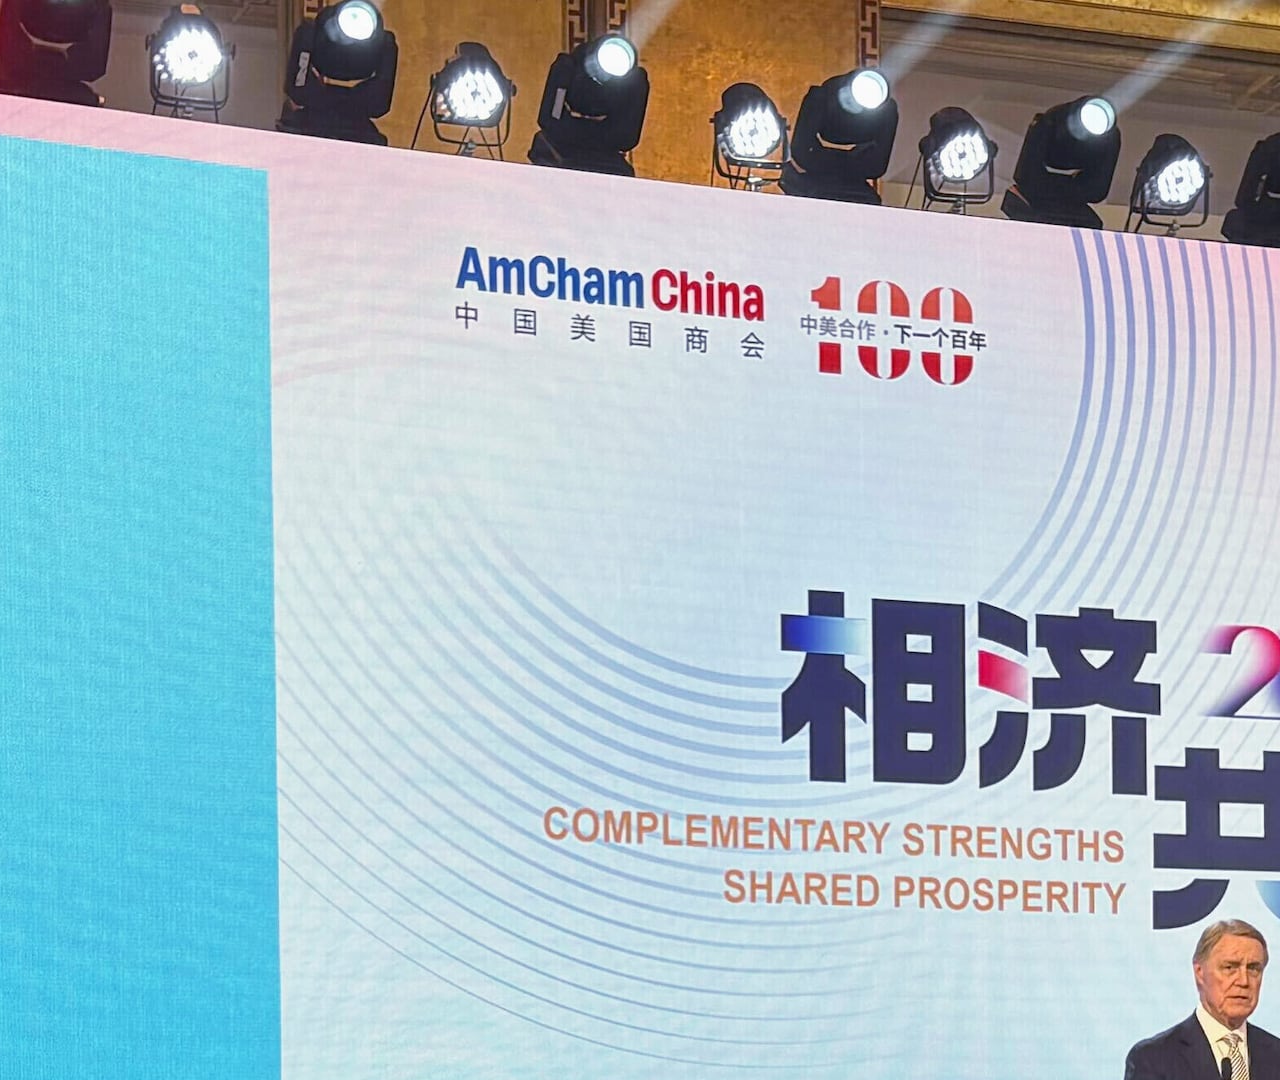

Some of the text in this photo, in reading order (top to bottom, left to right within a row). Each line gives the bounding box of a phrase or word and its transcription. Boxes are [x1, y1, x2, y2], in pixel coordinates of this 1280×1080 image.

[456, 246, 765, 322] AmCham China
[455, 301, 765, 360] 中国美国商会
[810, 276, 975, 386] 100
[780, 589, 1161, 796] 相济
[543, 806, 1125, 864] COMPLEMENTARY STRENGTHS
[723, 868, 1127, 915] SHARED PROSPERITY
